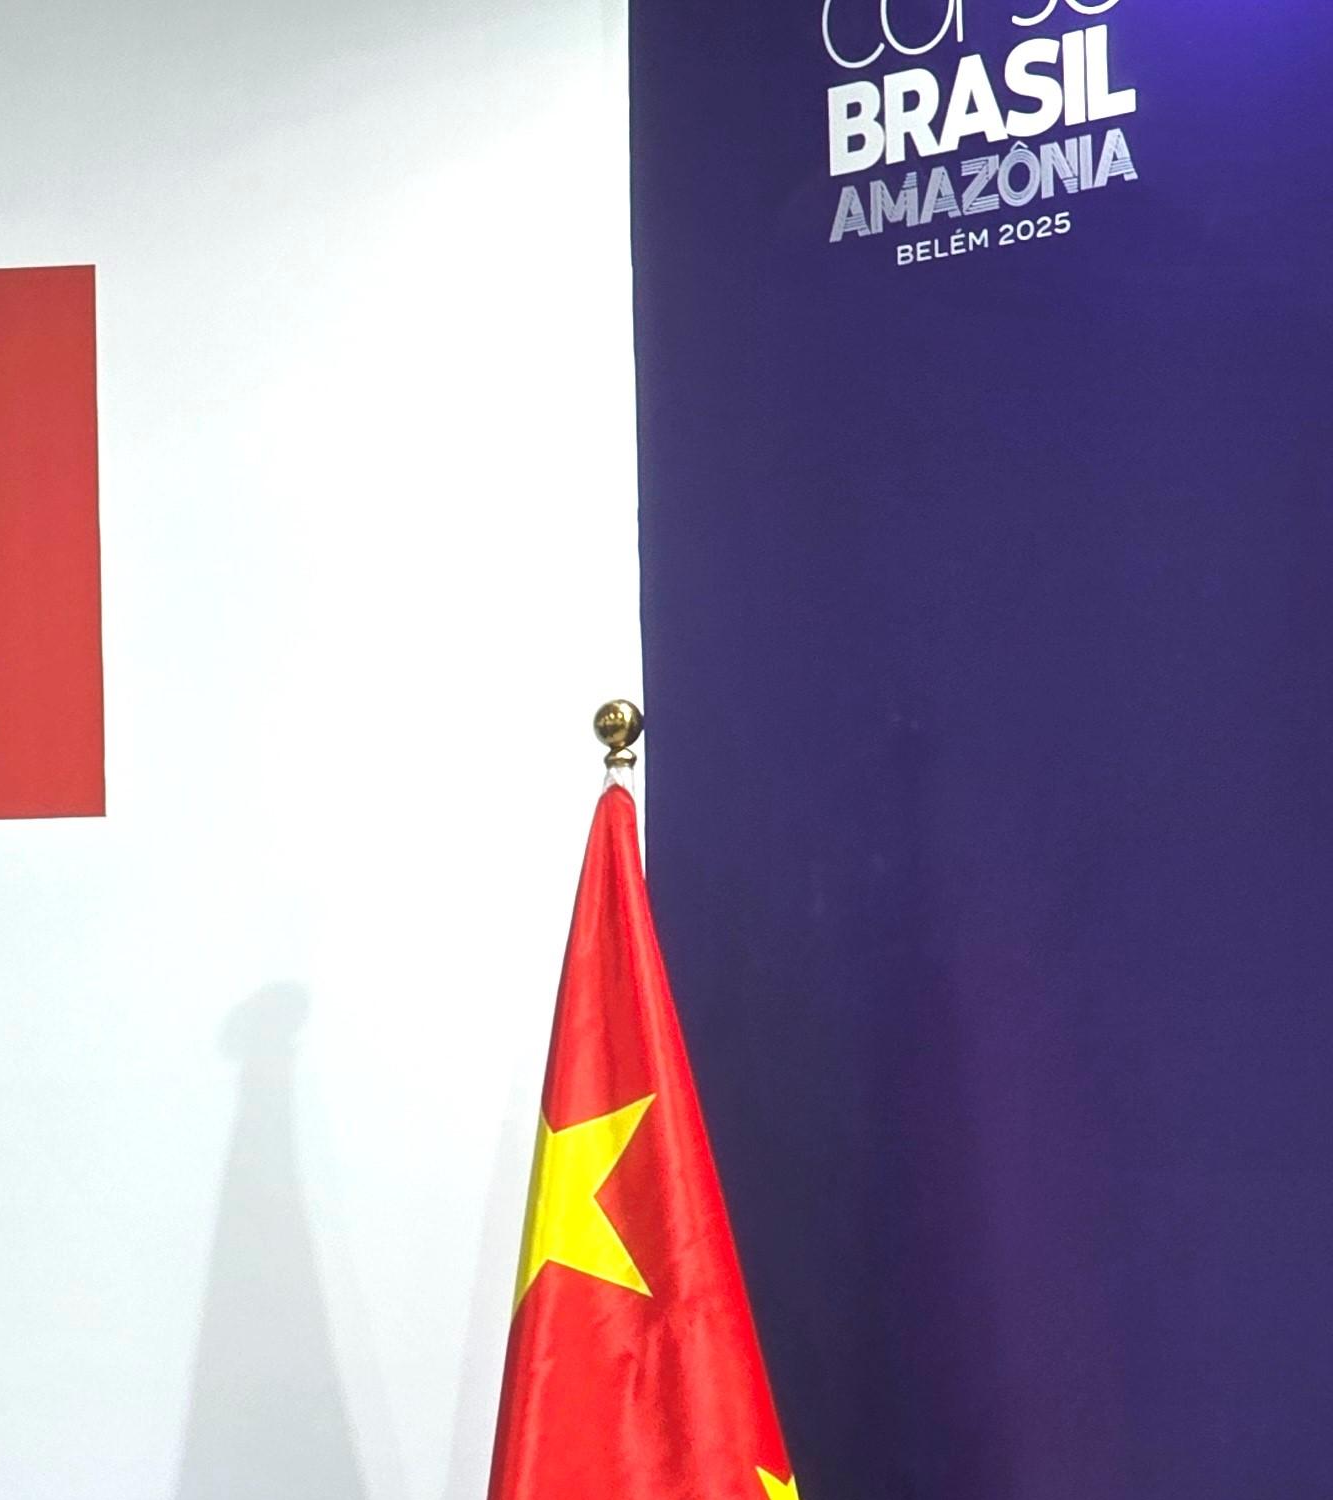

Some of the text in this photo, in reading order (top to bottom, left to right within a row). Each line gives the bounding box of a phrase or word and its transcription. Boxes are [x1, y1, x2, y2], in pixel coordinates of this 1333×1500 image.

[827, 24, 1137, 177] BRASIL
[829, 128, 1138, 243] AMAZÔNIA
[897, 211, 1072, 266] BELÉM 2025
